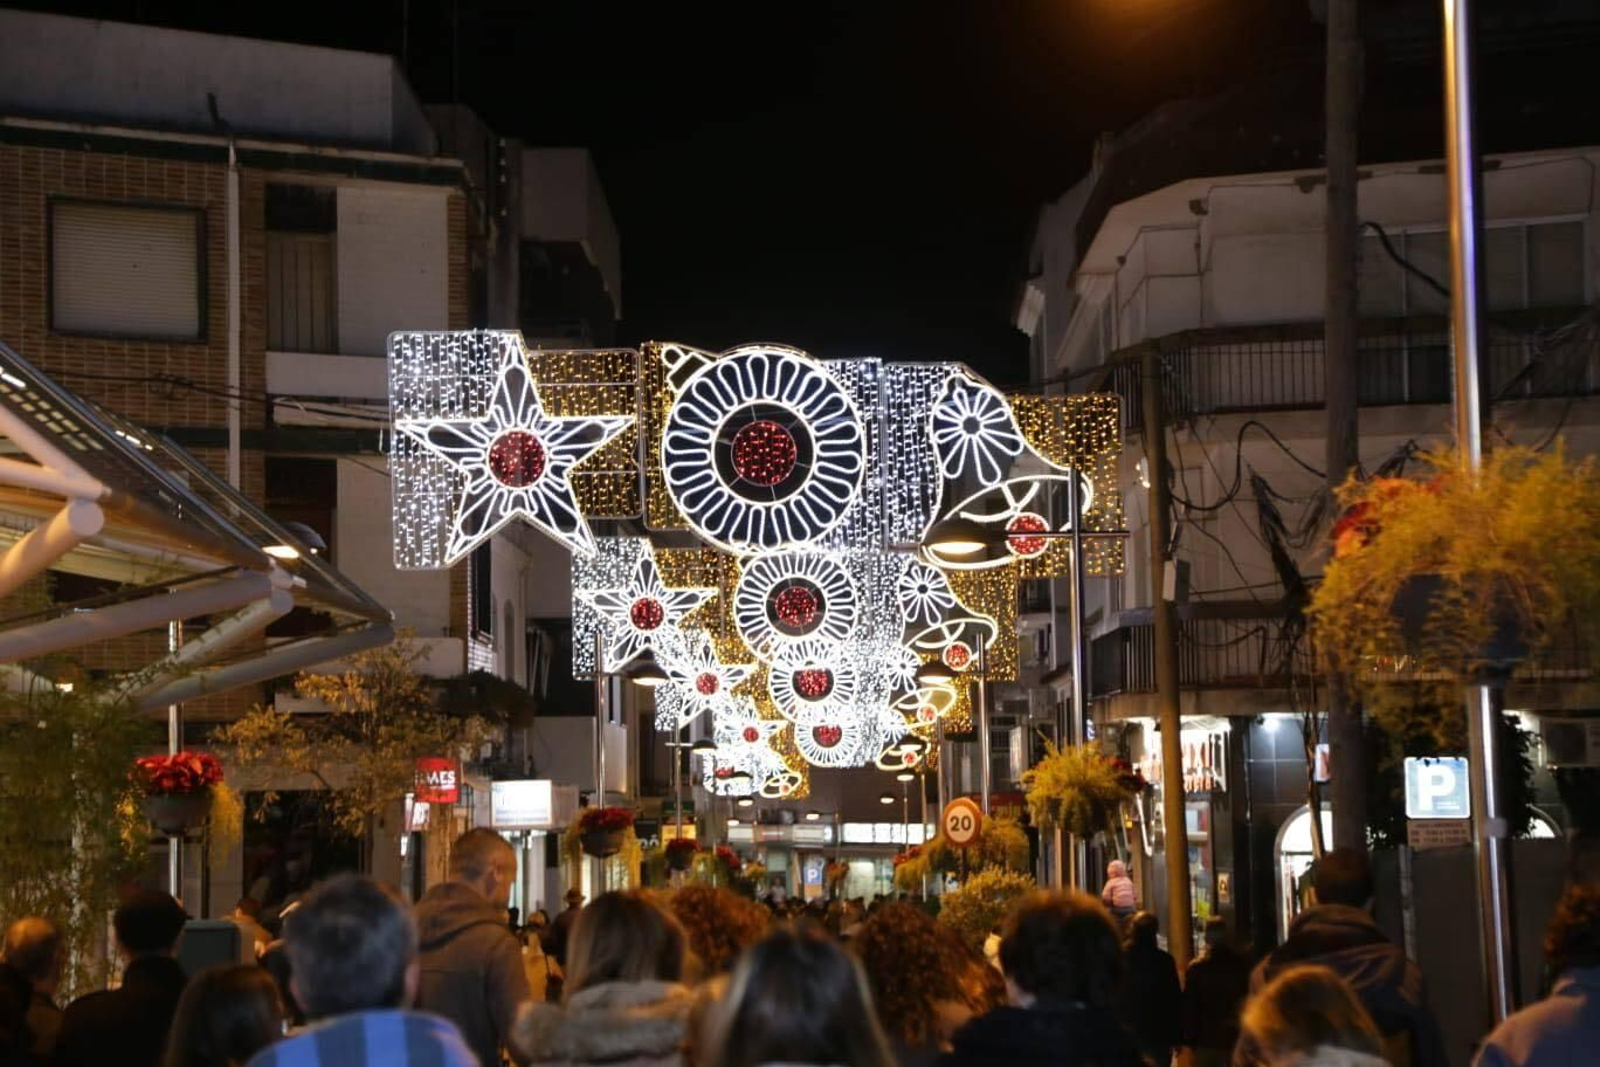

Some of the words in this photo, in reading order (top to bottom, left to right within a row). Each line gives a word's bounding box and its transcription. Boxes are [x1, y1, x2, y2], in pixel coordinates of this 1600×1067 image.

[1417, 765, 1456, 811] P
[950, 815, 971, 831] 20
[807, 868, 818, 883] P
